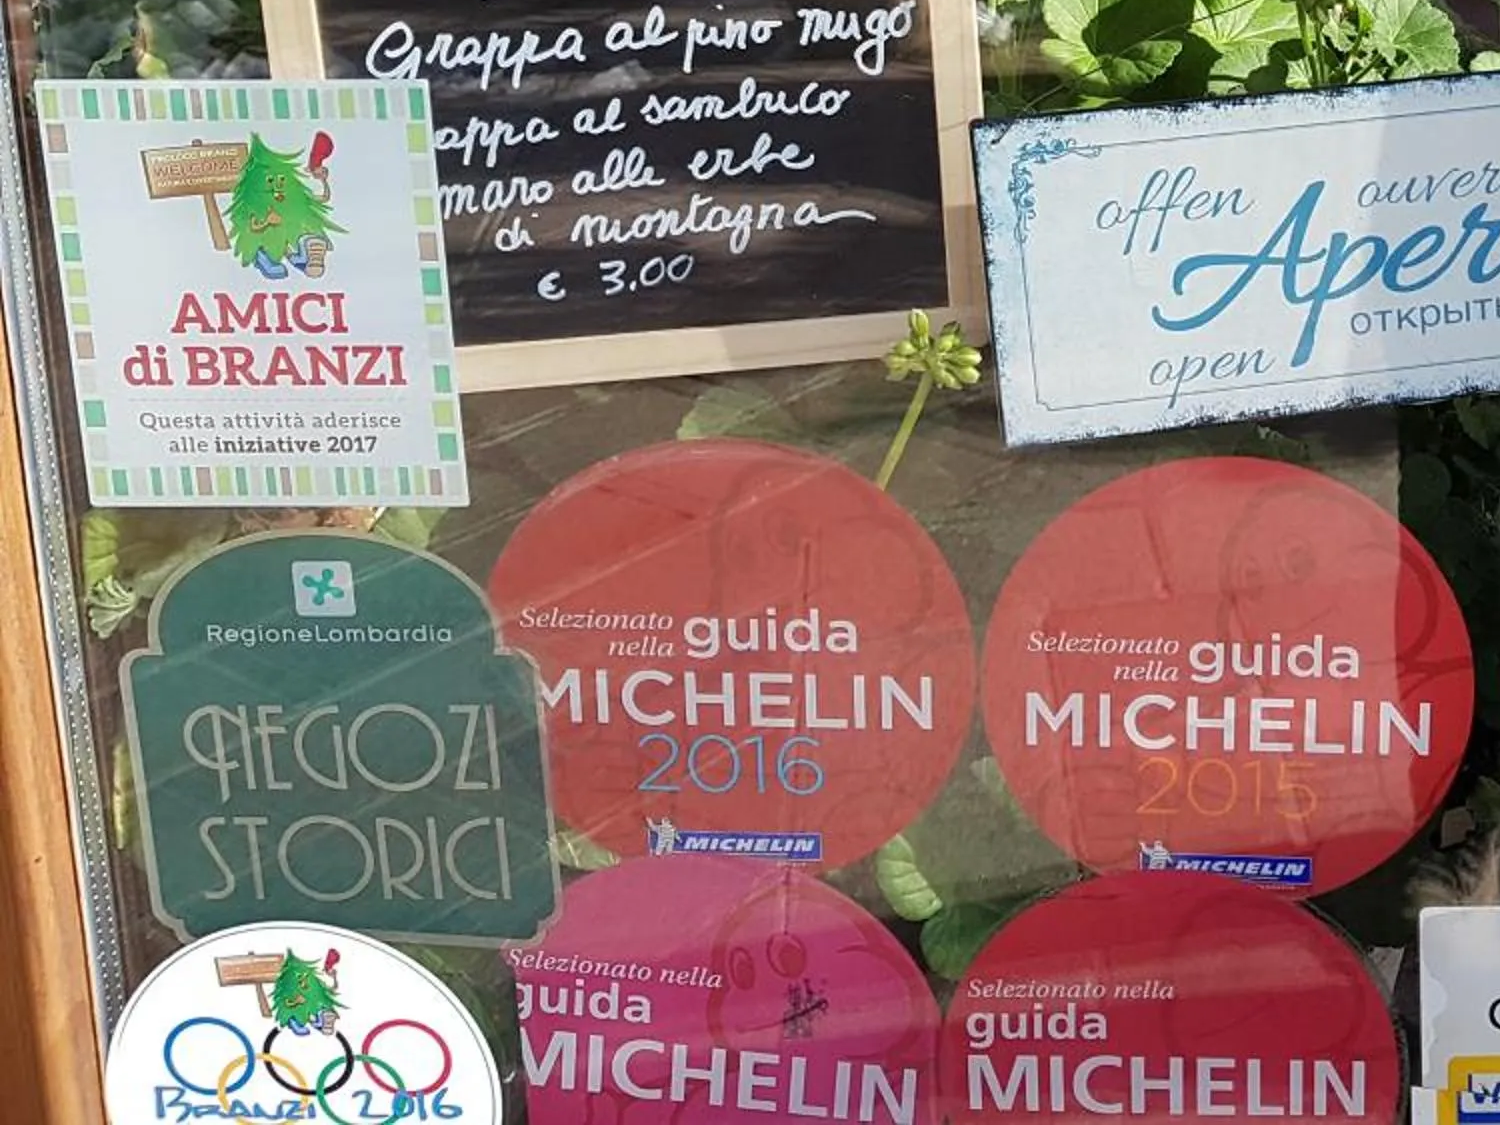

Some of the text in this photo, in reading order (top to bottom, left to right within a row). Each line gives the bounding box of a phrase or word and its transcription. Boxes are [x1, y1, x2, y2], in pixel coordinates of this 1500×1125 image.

[365, 0, 917, 90] Grappa al pino mugo
[434, 77, 852, 167] appa al sambuco
[437, 133, 815, 220] maro alle erbe
[495, 187, 878, 254] di montagna
[1096, 165, 1255, 256] offen
[537, 271, 567, 302] €
[171, 292, 350, 335] AMICI
[123, 345, 408, 386] di BRANZI
[1149, 343, 1277, 408] open
[139, 410, 402, 430] Questa attività aderisce
[169, 436, 378, 454] alle iniziative 2017
[520, 606, 674, 630] Selezionato
[683, 608, 859, 659] guida
[608, 637, 675, 657] nella
[1027, 631, 1180, 657] Selezionato
[1189, 633, 1361, 684] guida
[1113, 662, 1180, 683] nella
[541, 668, 934, 731] MICHELIN
[1026, 692, 1432, 756] MICHELIN
[183, 703, 502, 804] NEGOZI
[637, 733, 826, 795] 2016
[1135, 756, 1318, 821] 2015
[200, 815, 513, 901] STORICI
[684, 836, 816, 854] MICHELIN
[1175, 858, 1307, 877] MICHELIN
[508, 949, 724, 989] Selezionato nella
[967, 978, 1175, 1000] Selezionato nella
[514, 978, 653, 1024] guida
[966, 1002, 1109, 1049] guida
[520, 1027, 918, 1125] MICHELIN
[967, 1053, 1367, 1116] MICHELIN
[351, 1086, 464, 1120] 2016
